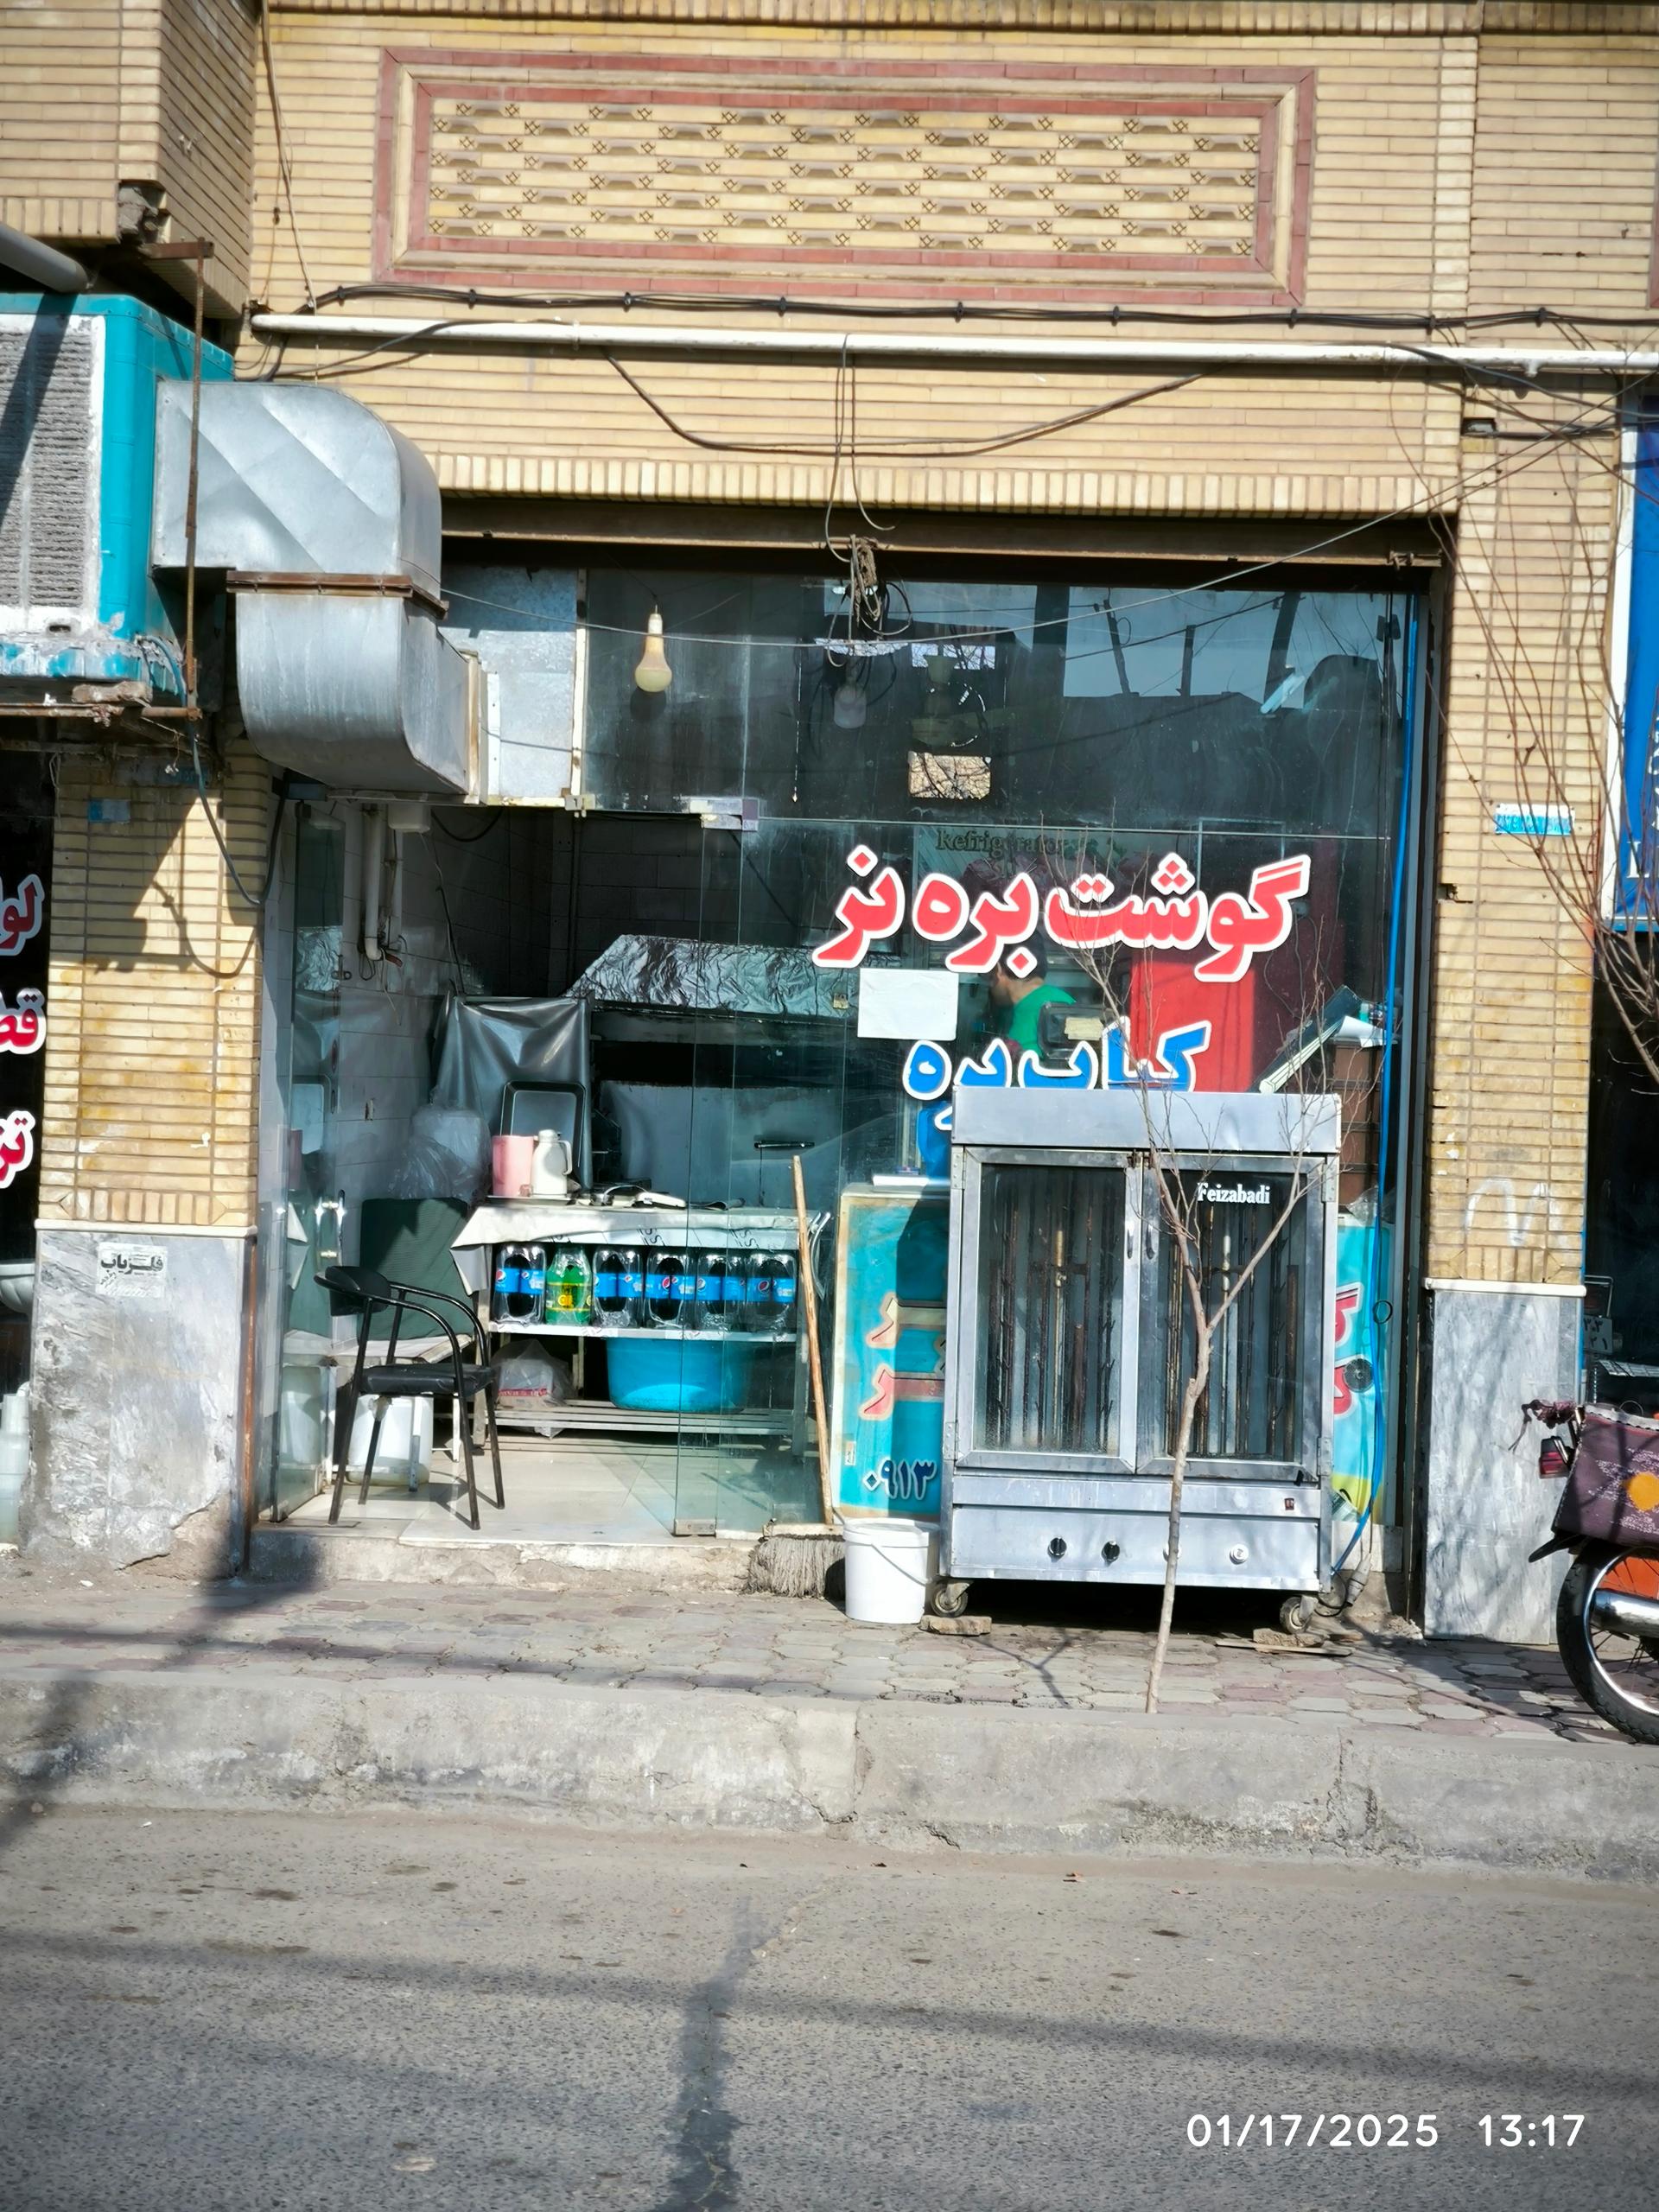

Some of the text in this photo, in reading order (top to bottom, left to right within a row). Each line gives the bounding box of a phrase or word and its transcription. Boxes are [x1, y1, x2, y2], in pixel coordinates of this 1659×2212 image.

[812, 844, 1311, 982] گوشت بره نر
[1197, 1183, 1270, 1204] Feizabadi
